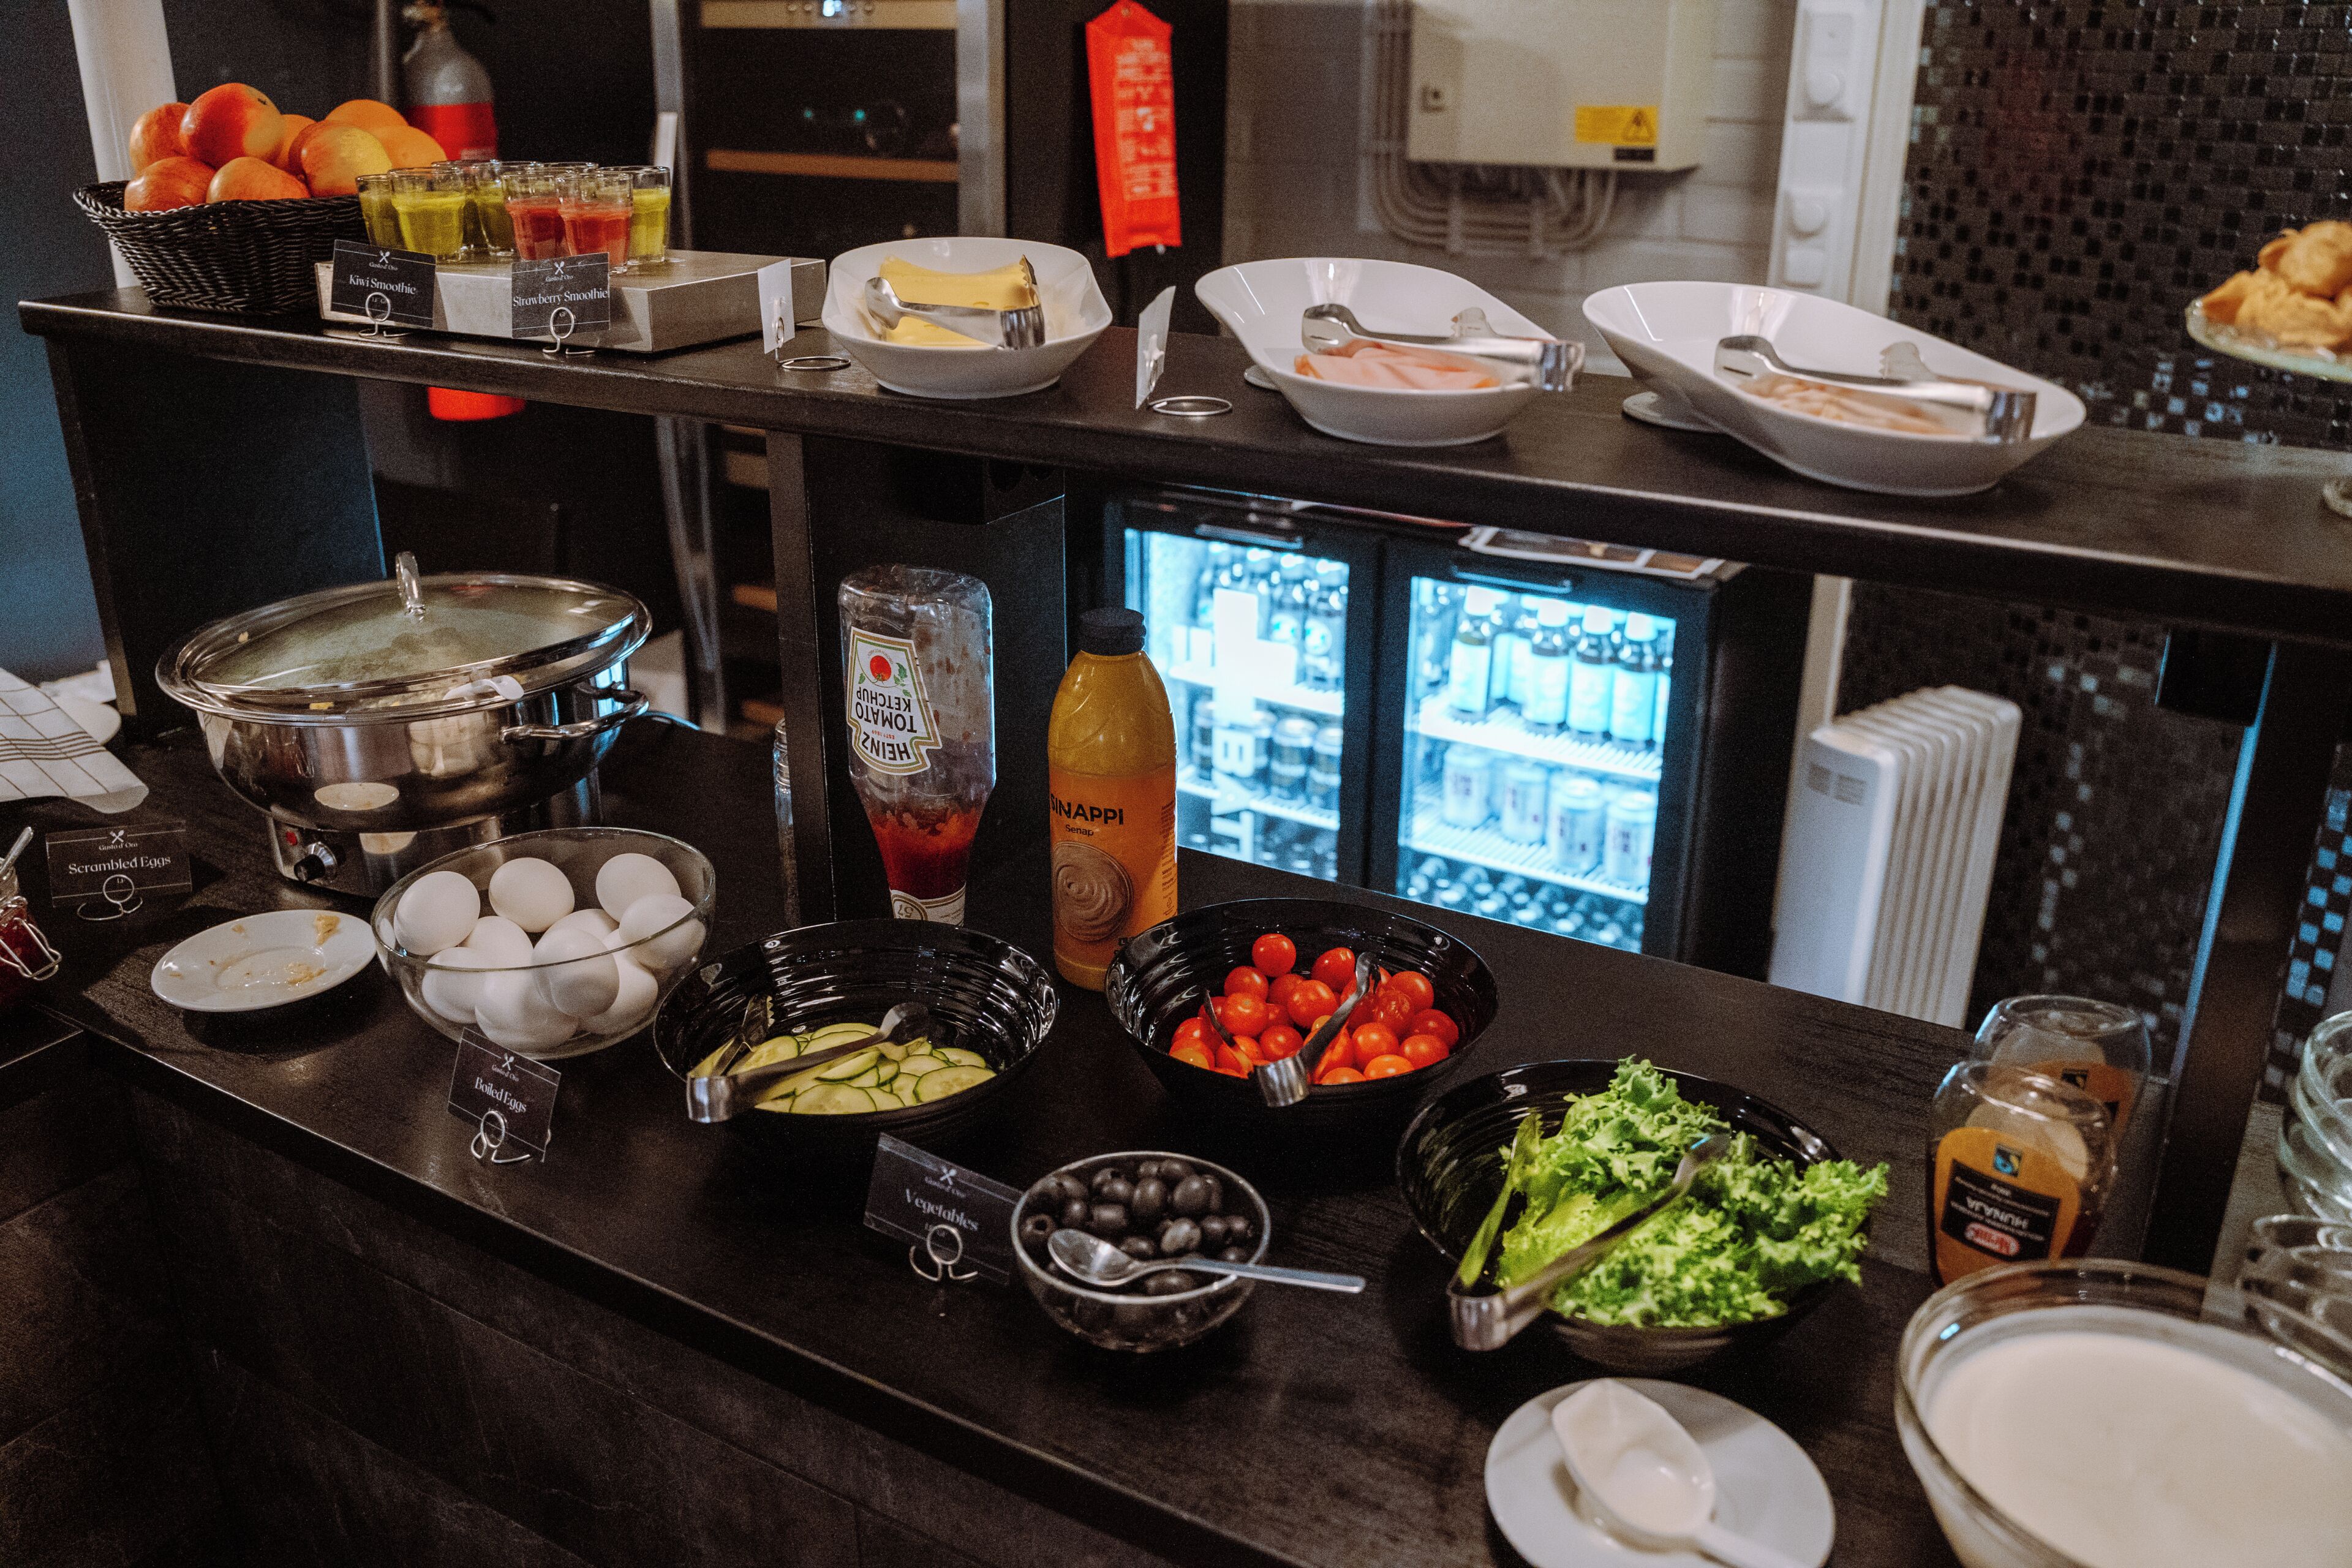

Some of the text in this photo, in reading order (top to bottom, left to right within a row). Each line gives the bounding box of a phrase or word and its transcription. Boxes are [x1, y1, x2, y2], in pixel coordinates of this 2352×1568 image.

[349, 274, 417, 295] Kiwi Smoothie
[513, 288, 608, 306] Strawberry Smoothie
[856, 686, 911, 712] KETCHUP
[855, 701, 918, 733] TOMATO
[861, 731, 911, 761] HEINZ
[1050, 793, 1124, 824] SINAPPI
[1066, 824, 1094, 837] Senap
[69, 856, 171, 875] Scrambled Eggs
[897, 904, 914, 918] 57
[475, 1077, 527, 1113] Boiled Eggs
[905, 1188, 979, 1232] Vegetables
[1966, 1196, 2029, 1229] HUNAJA
